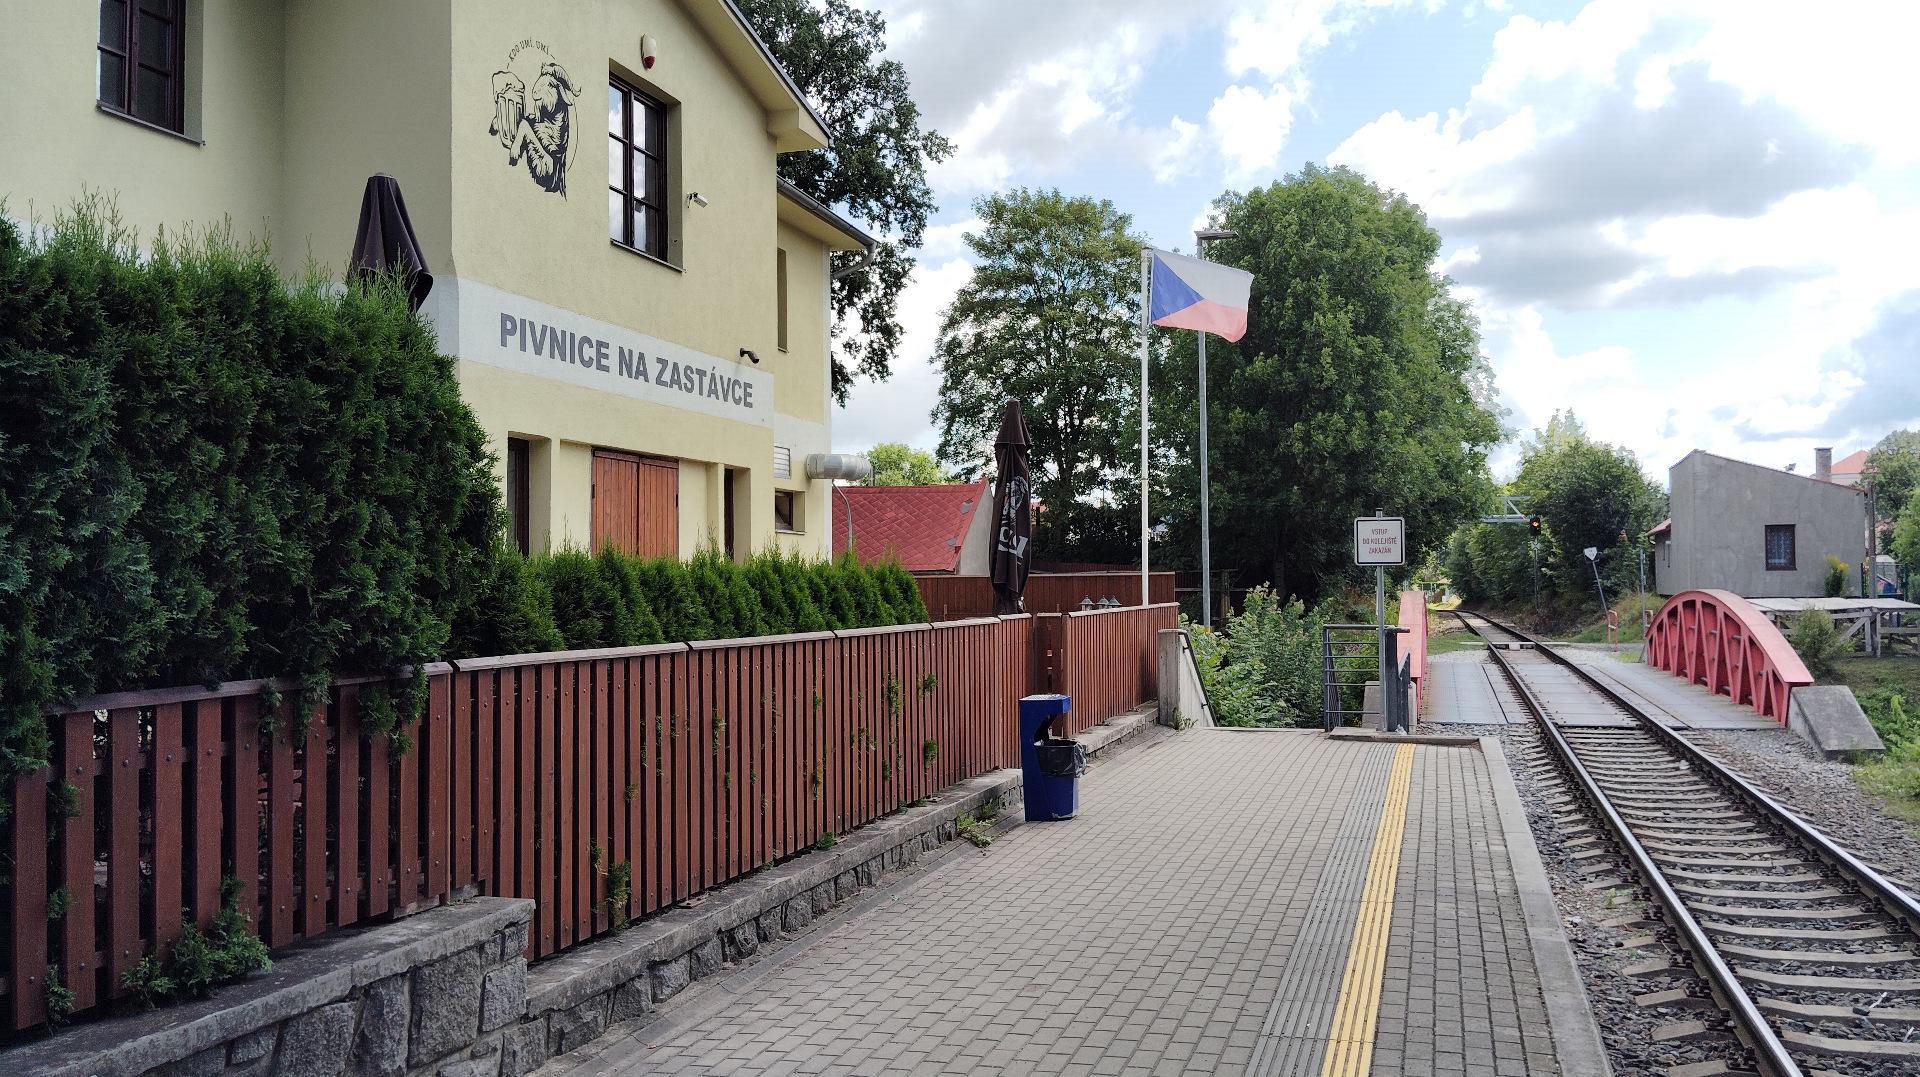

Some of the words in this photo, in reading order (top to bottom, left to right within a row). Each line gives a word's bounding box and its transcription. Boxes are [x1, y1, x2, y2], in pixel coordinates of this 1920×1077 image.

[500, 312, 610, 373] PIVNICE
[618, 345, 650, 384] NA
[655, 356, 754, 409] ZASTÁVCE
